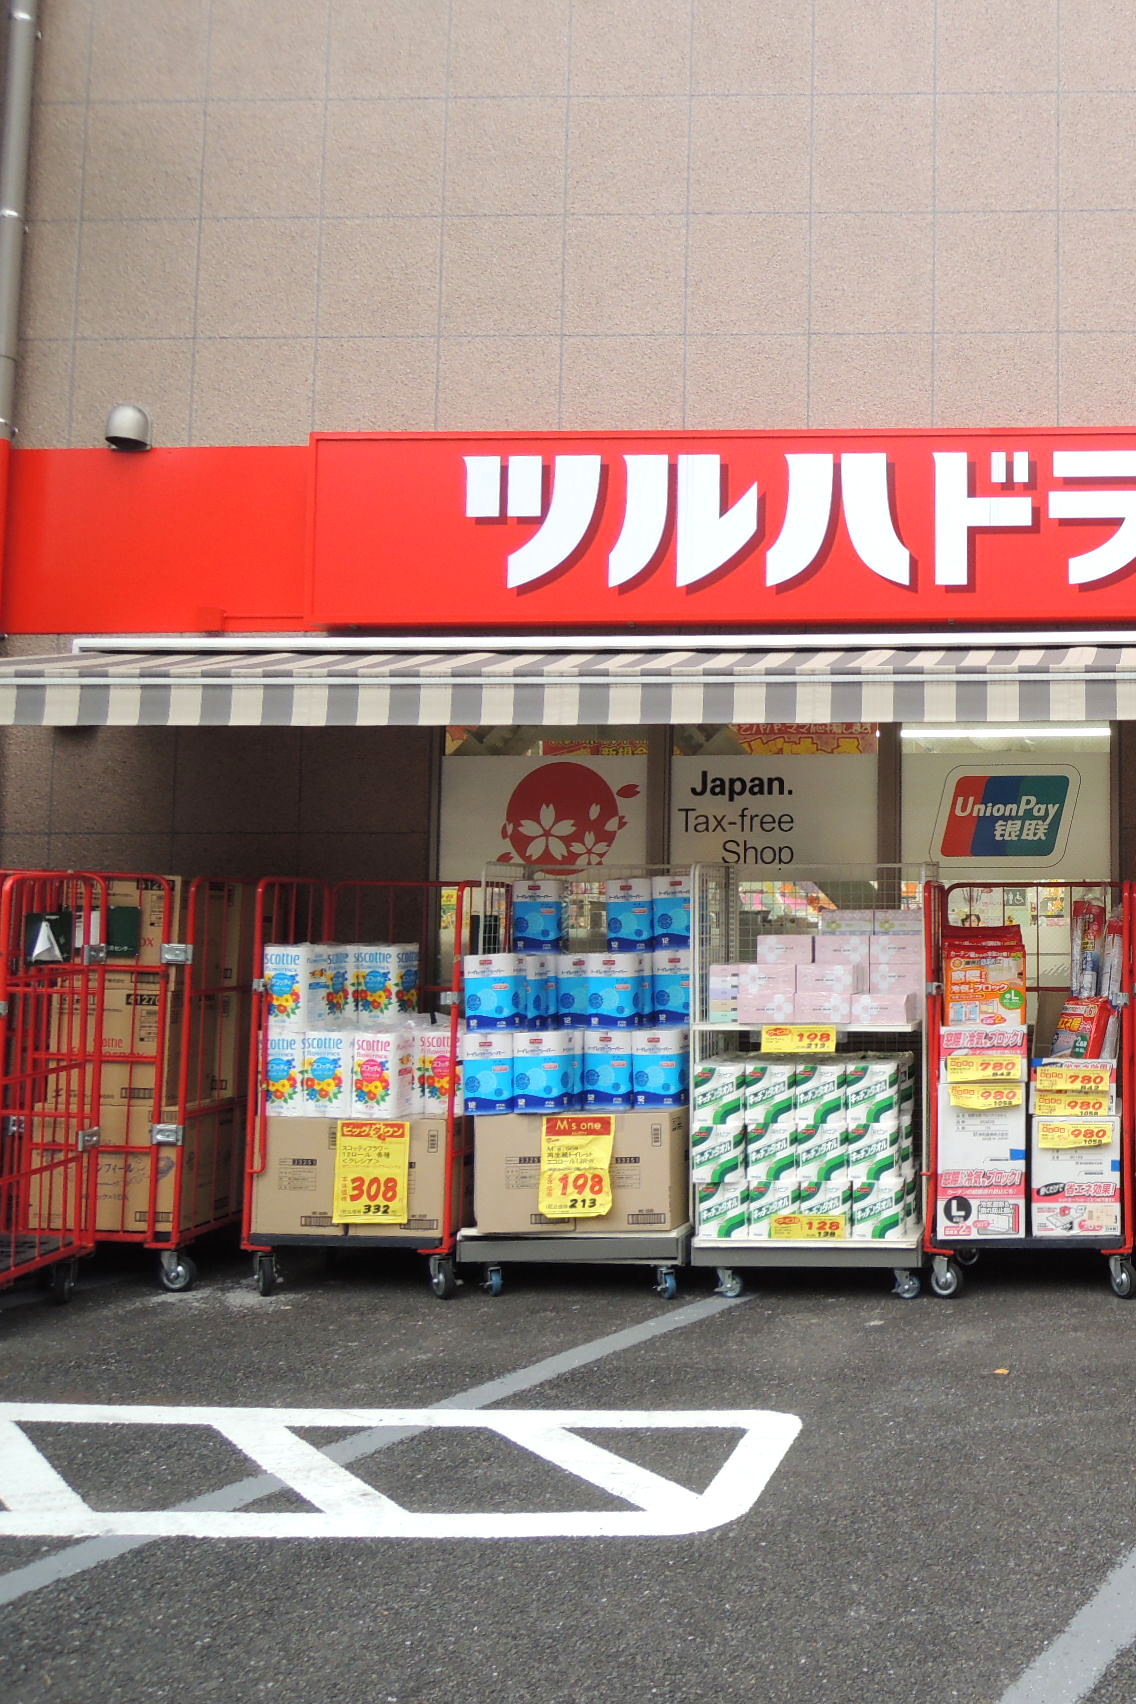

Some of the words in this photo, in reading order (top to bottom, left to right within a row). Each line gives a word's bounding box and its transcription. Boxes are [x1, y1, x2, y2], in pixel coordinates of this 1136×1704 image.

[690, 770, 793, 802] Japan.
[954, 795, 1060, 825] UnionPay
[678, 807, 795, 833] Tax-free
[993, 819, 1050, 841] 银联
[721, 839, 795, 869] Shop
[797, 1032, 831, 1043] 198
[356, 1039, 390, 1052] scottie
[979, 1062, 1017, 1072] 780
[1068, 1075, 1104, 1085] 780
[1067, 1100, 1103, 1111] 980
[343, 1123, 403, 1137] ビッグダウン
[555, 1118, 577, 1130] M's
[580, 1121, 602, 1130] one
[1070, 1129, 1107, 1139] 980
[349, 1176, 398, 1202] 308
[558, 1173, 604, 1196] 198
[1066, 1183, 1116, 1197] 省エネ効果!
[362, 1204, 390, 1214] 332
[569, 1198, 597, 1208] 213
[951, 1200, 966, 1217] L
[806, 1221, 840, 1231] 128
